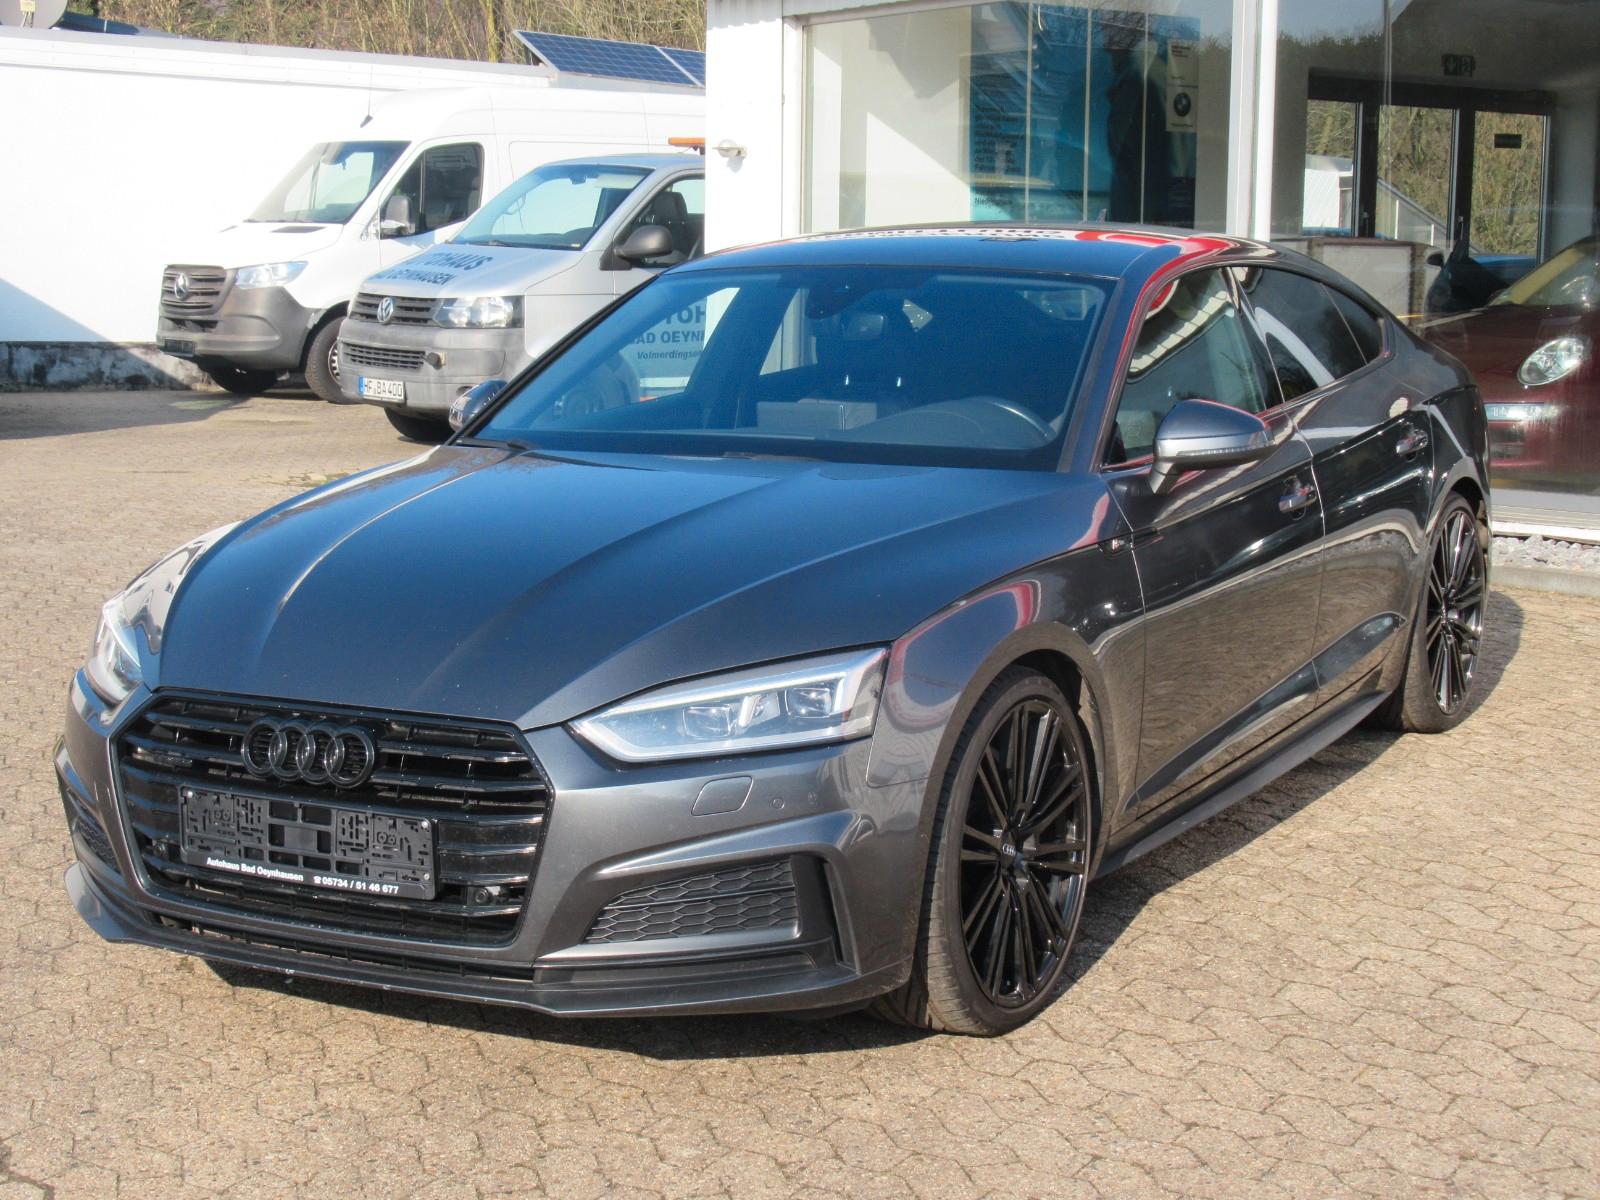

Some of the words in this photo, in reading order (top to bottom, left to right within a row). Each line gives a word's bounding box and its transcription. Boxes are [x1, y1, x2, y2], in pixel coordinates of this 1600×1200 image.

[206, 857, 240, 871] Autohaus
[240, 862, 256, 874] Bad
[256, 866, 304, 882] Oeynhausen
[322, 876, 348, 889] 05734
[355, 880, 366, 891] 51
[368, 882, 381, 892] 46
[381, 884, 400, 895] 677
